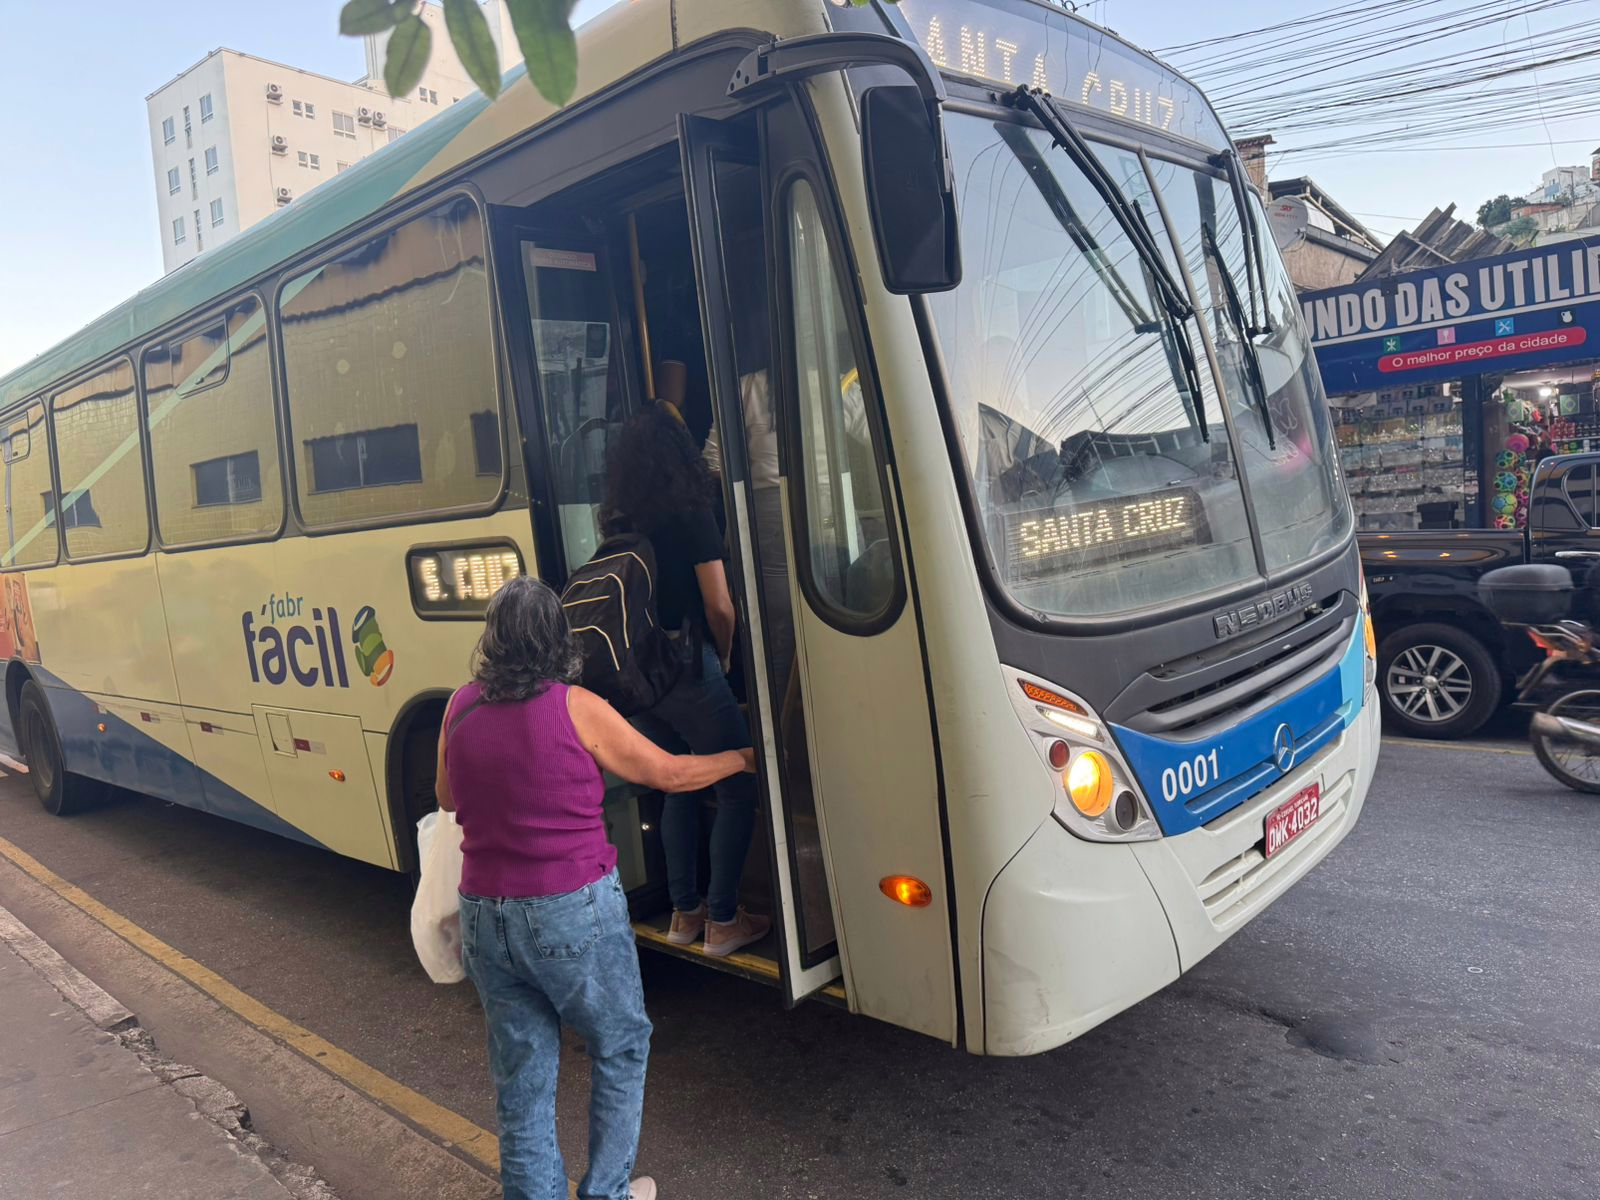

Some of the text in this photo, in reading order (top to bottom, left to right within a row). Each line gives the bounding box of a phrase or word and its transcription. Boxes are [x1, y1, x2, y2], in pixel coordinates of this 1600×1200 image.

[1395, 272, 1470, 327] DAS
[1392, 333, 1568, 368] O melhor preço da cidade
[1020, 496, 1187, 556] SANTA CRUZ
[269, 592, 303, 625] fabr
[1213, 583, 1313, 638] NEOBUS
[242, 604, 350, 689] fácil
[1161, 748, 1219, 803] 0001
